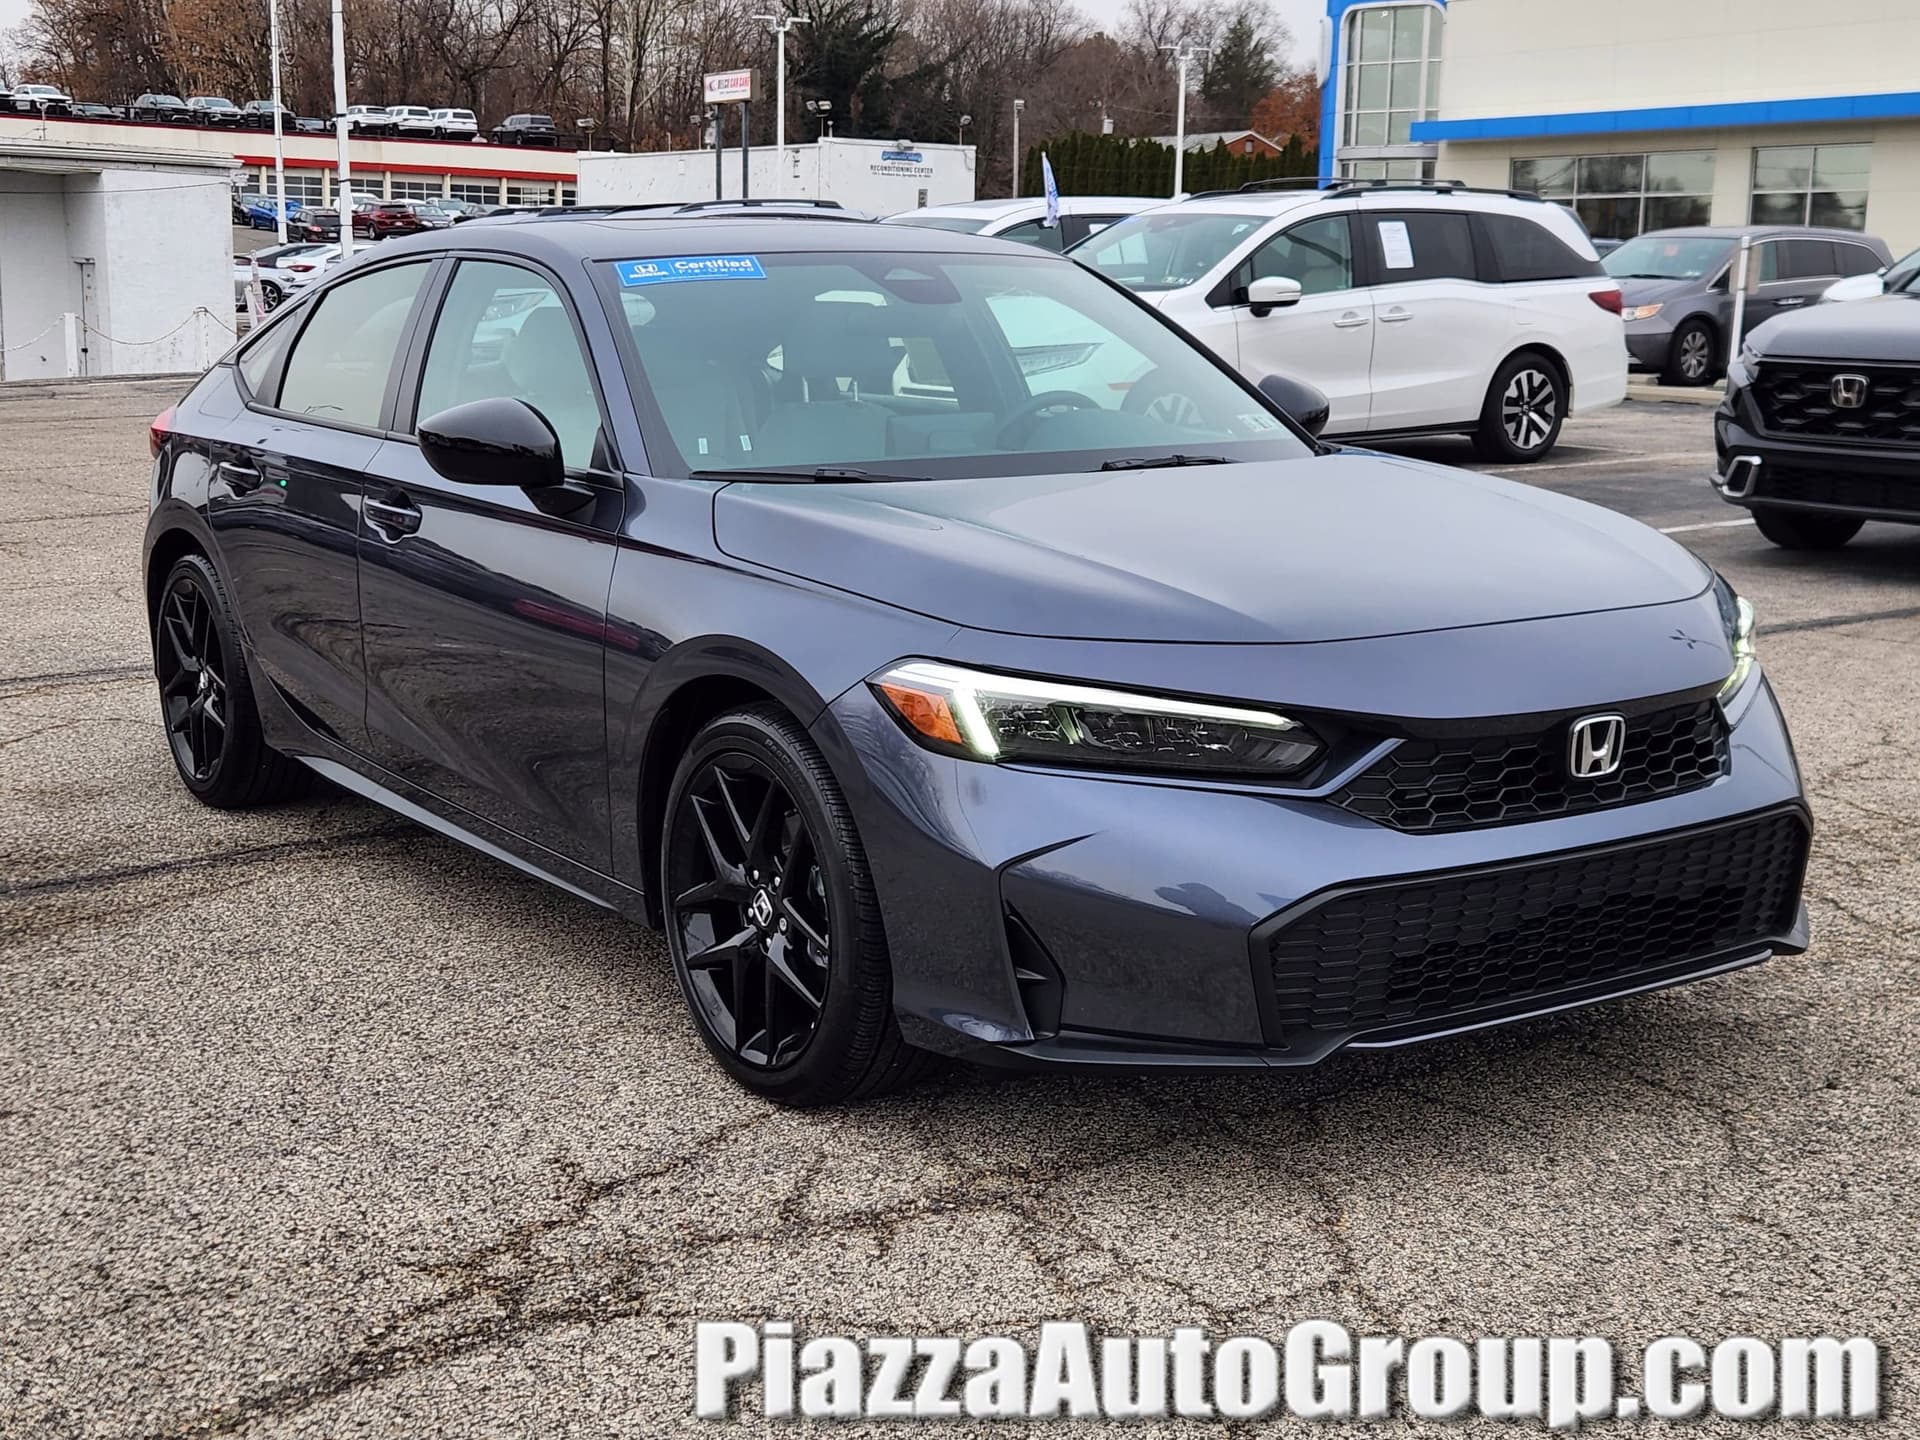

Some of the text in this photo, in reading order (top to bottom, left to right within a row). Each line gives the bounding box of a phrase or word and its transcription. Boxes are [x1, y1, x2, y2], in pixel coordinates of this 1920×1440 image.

[870, 164, 933, 174] RECONDITIONING CENTER
[674, 259, 752, 270] Certified
[678, 266, 755, 274] Pre-Owned
